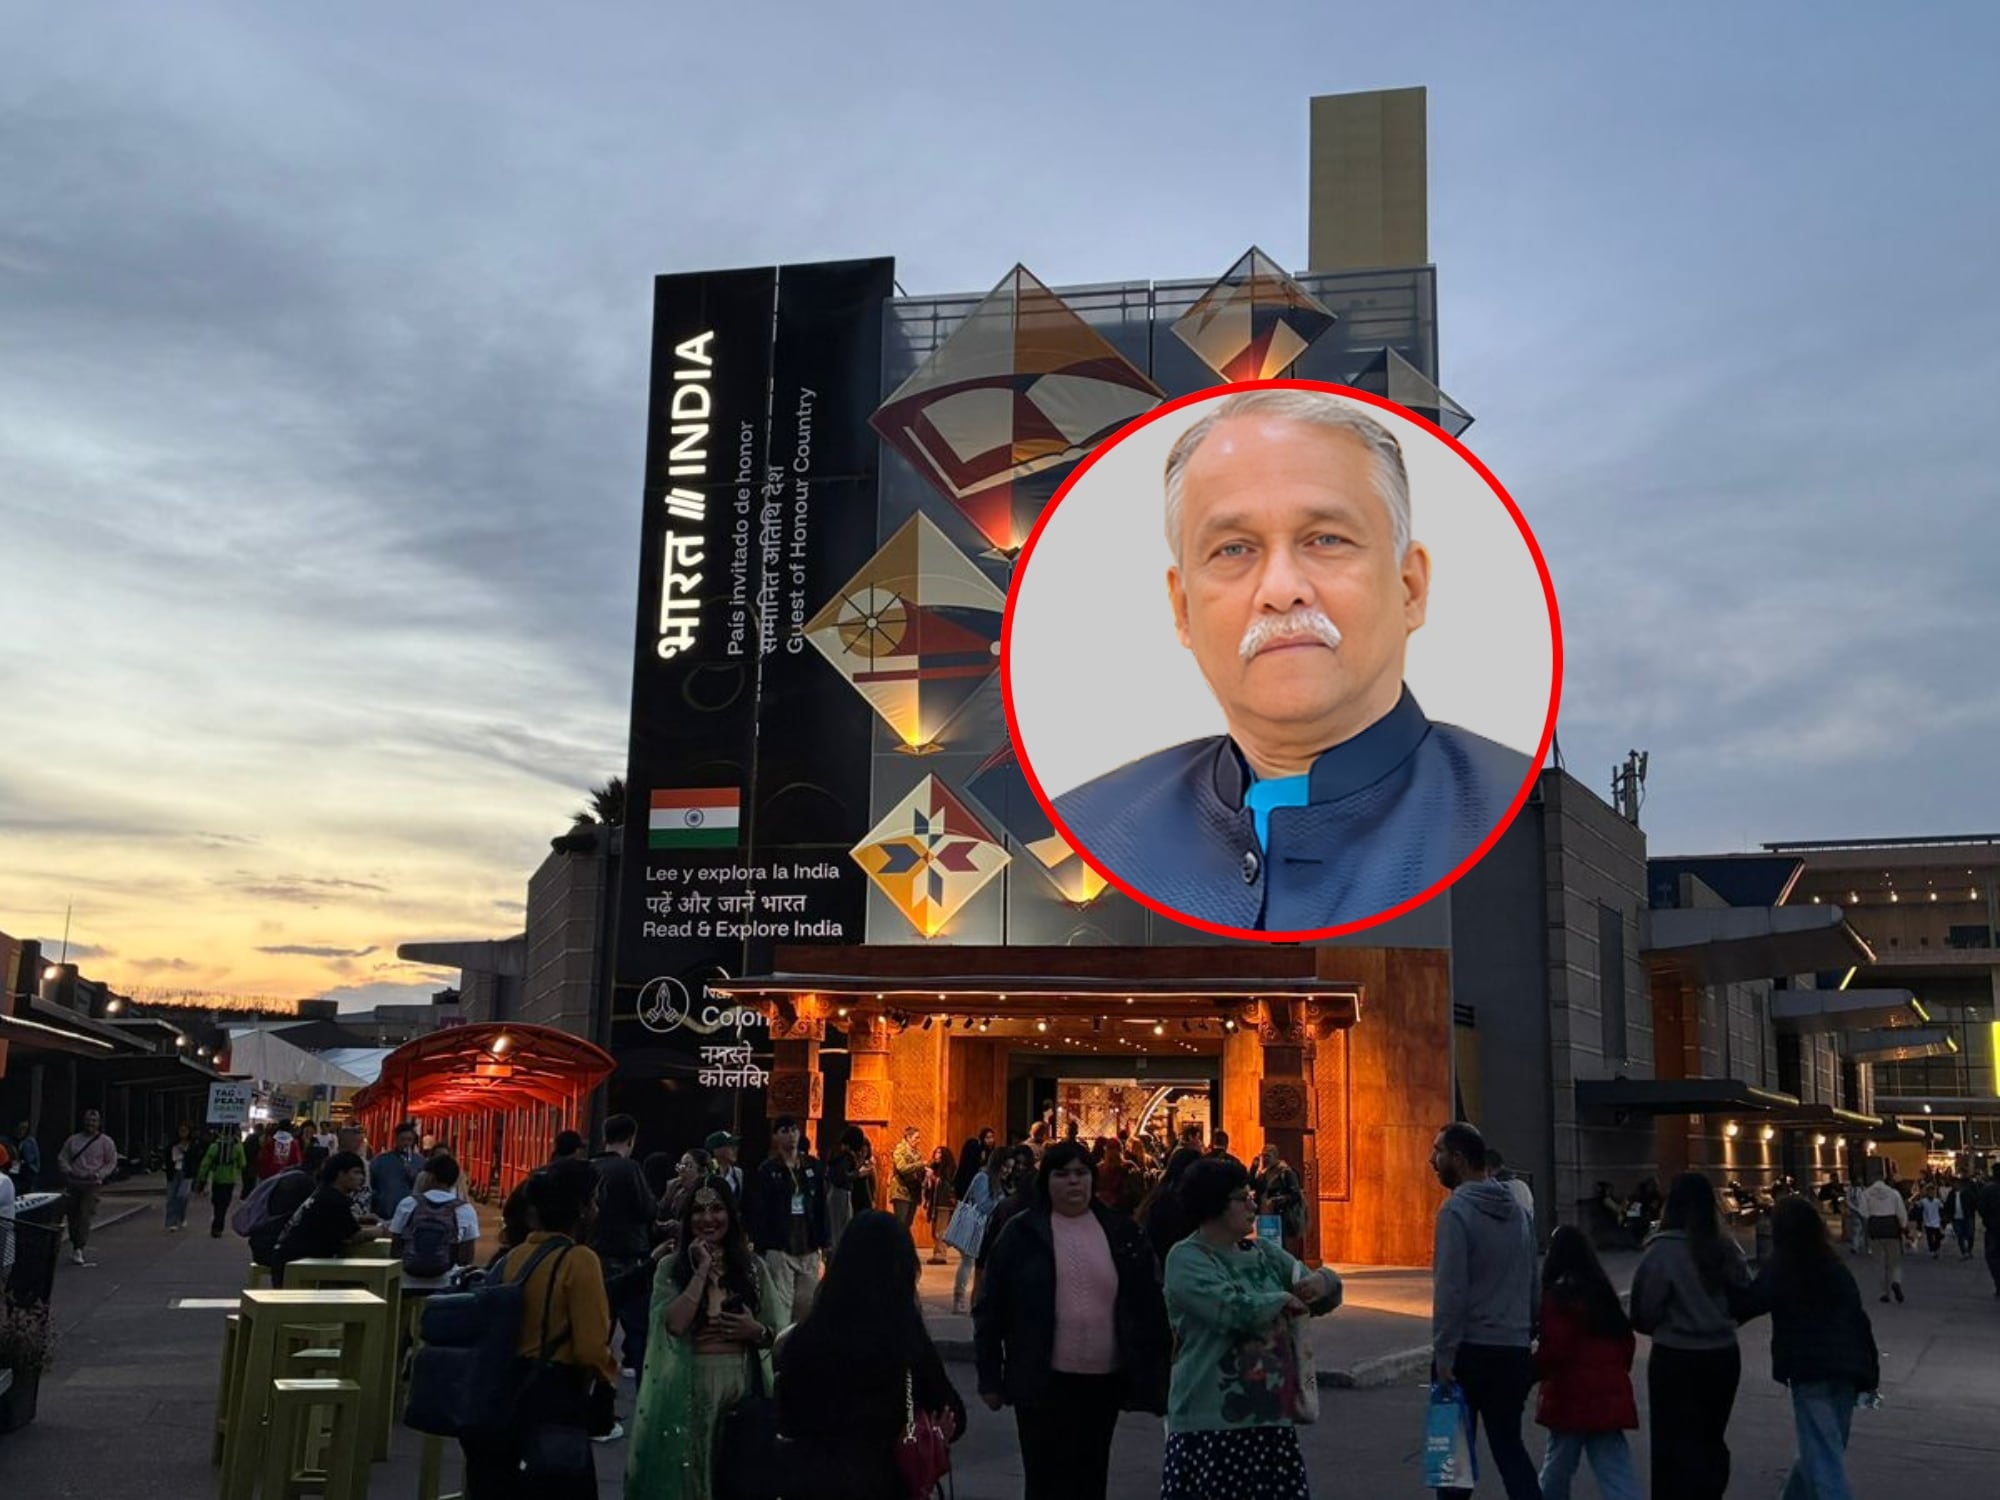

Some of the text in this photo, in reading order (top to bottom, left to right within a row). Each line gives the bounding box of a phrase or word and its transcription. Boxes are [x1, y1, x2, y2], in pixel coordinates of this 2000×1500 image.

[669, 330, 714, 476] INDIA
[727, 420, 753, 655] País invitado de honor
[756, 465, 785, 654] सम्मानित अतिथि देश
[787, 387, 817, 654] Guest of Honour Country
[658, 531, 705, 659] भारत
[642, 919, 843, 941] Read & Explore India
[646, 863, 840, 885] Lee y explora la India
[646, 889, 808, 918] पढ़ें और जानें भारत
[700, 1040, 753, 1065] नमस्ते
